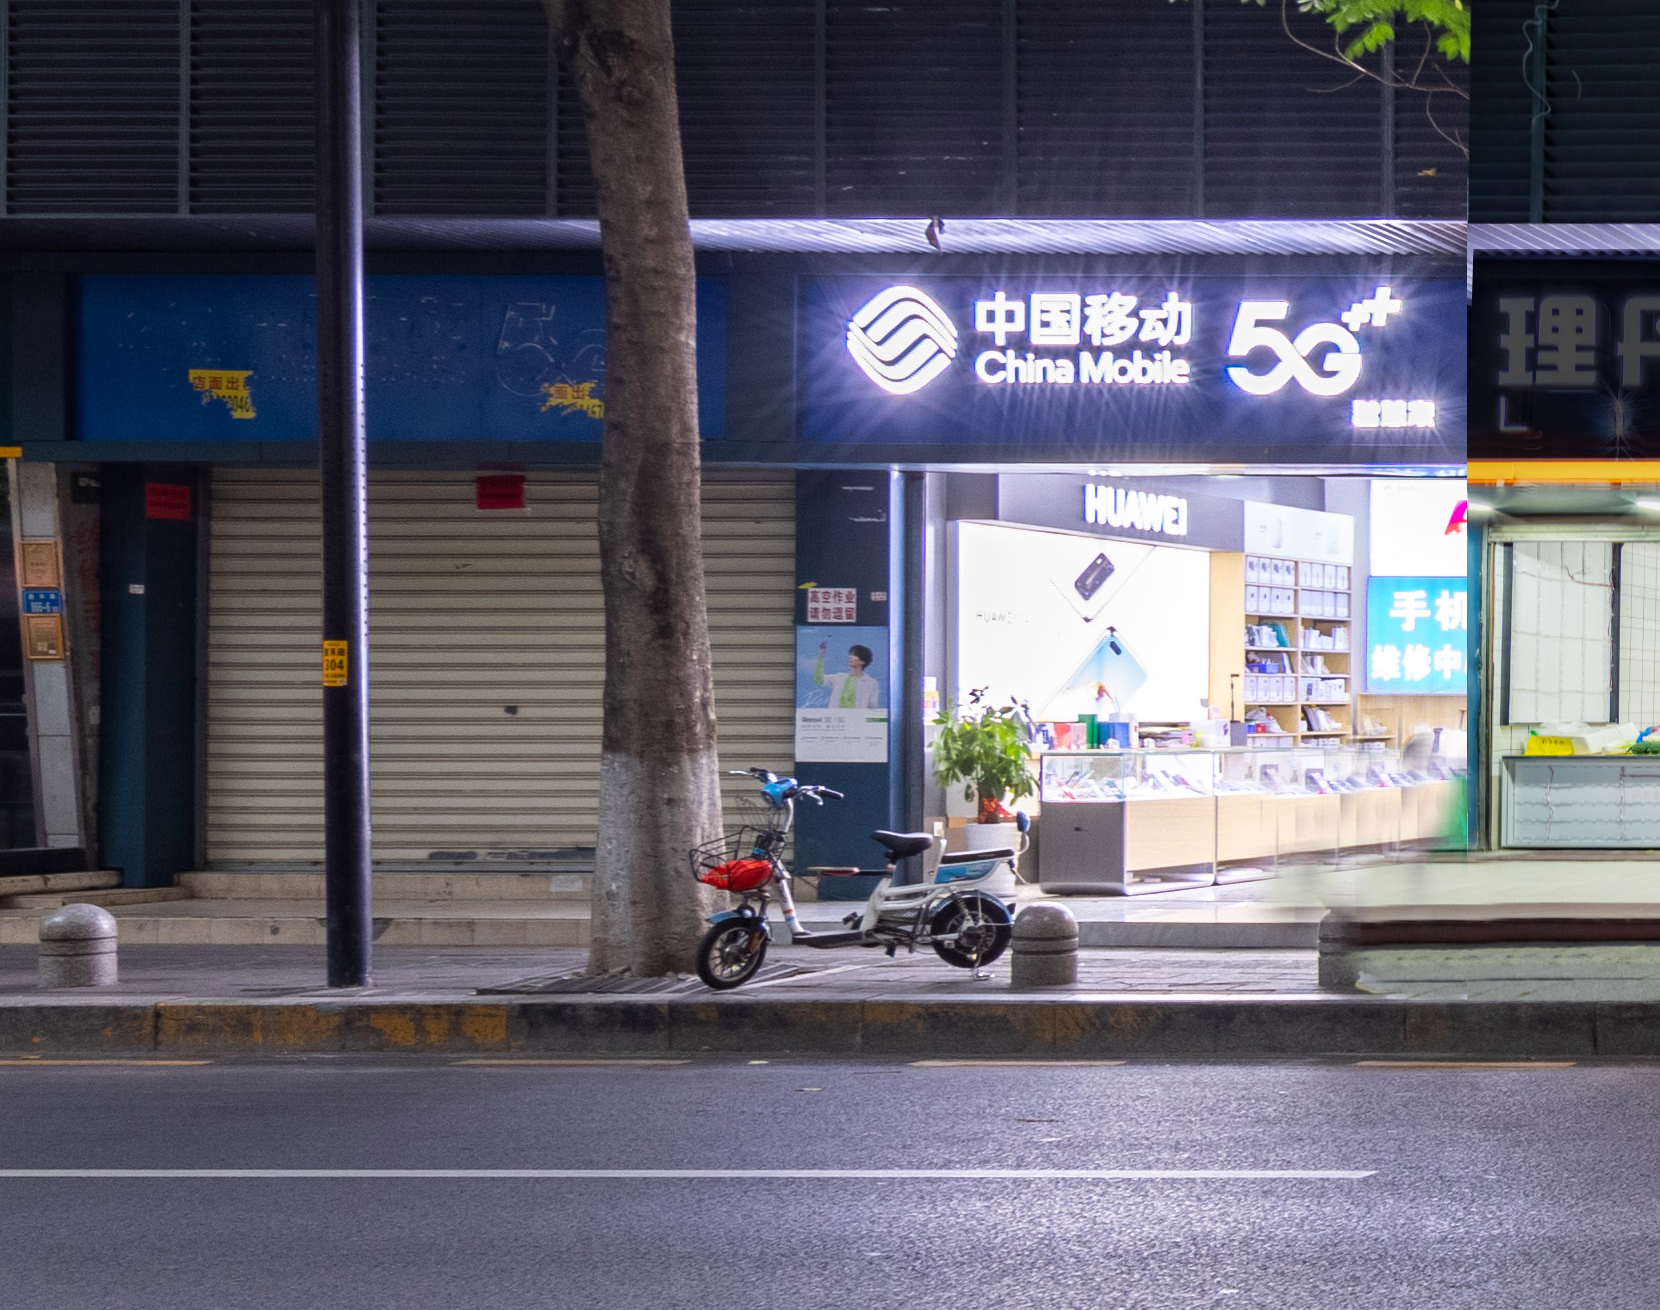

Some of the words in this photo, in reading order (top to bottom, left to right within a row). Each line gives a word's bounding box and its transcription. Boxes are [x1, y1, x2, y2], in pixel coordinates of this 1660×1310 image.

[975, 291, 1192, 346] 中国移动
[192, 376, 247, 390] 店面出
[975, 351, 1075, 384] China
[1079, 351, 1191, 384] Mobile
[1084, 483, 1187, 536] HUAWEI
[810, 591, 856, 604] 高空作业
[1371, 643, 1467, 681] 维修中
